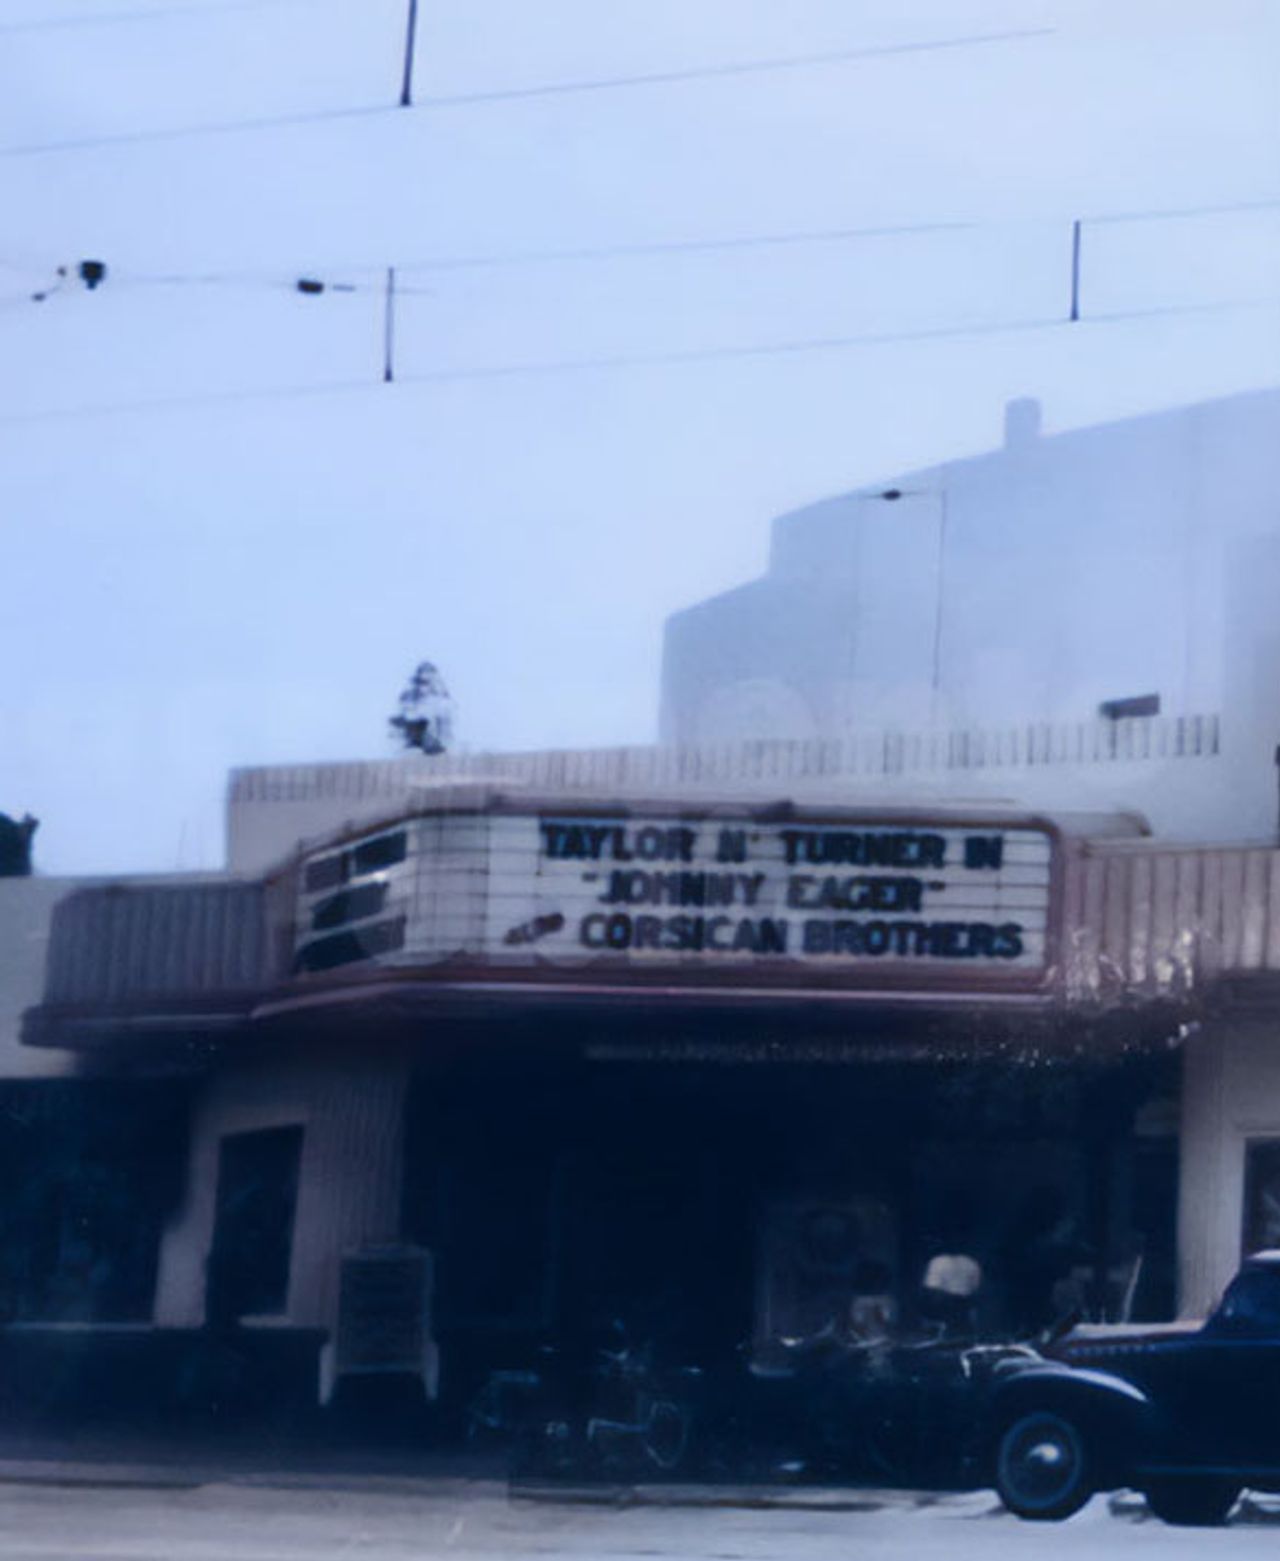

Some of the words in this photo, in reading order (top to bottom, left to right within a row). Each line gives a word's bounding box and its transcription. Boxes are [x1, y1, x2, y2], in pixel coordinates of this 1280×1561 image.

[540, 823, 697, 862] TAYLOR
[779, 829, 946, 870] TURNER
[963, 836, 1004, 870] IN
[578, 913, 788, 955] CORSICAN
[802, 918, 1023, 959] BROTHERS
